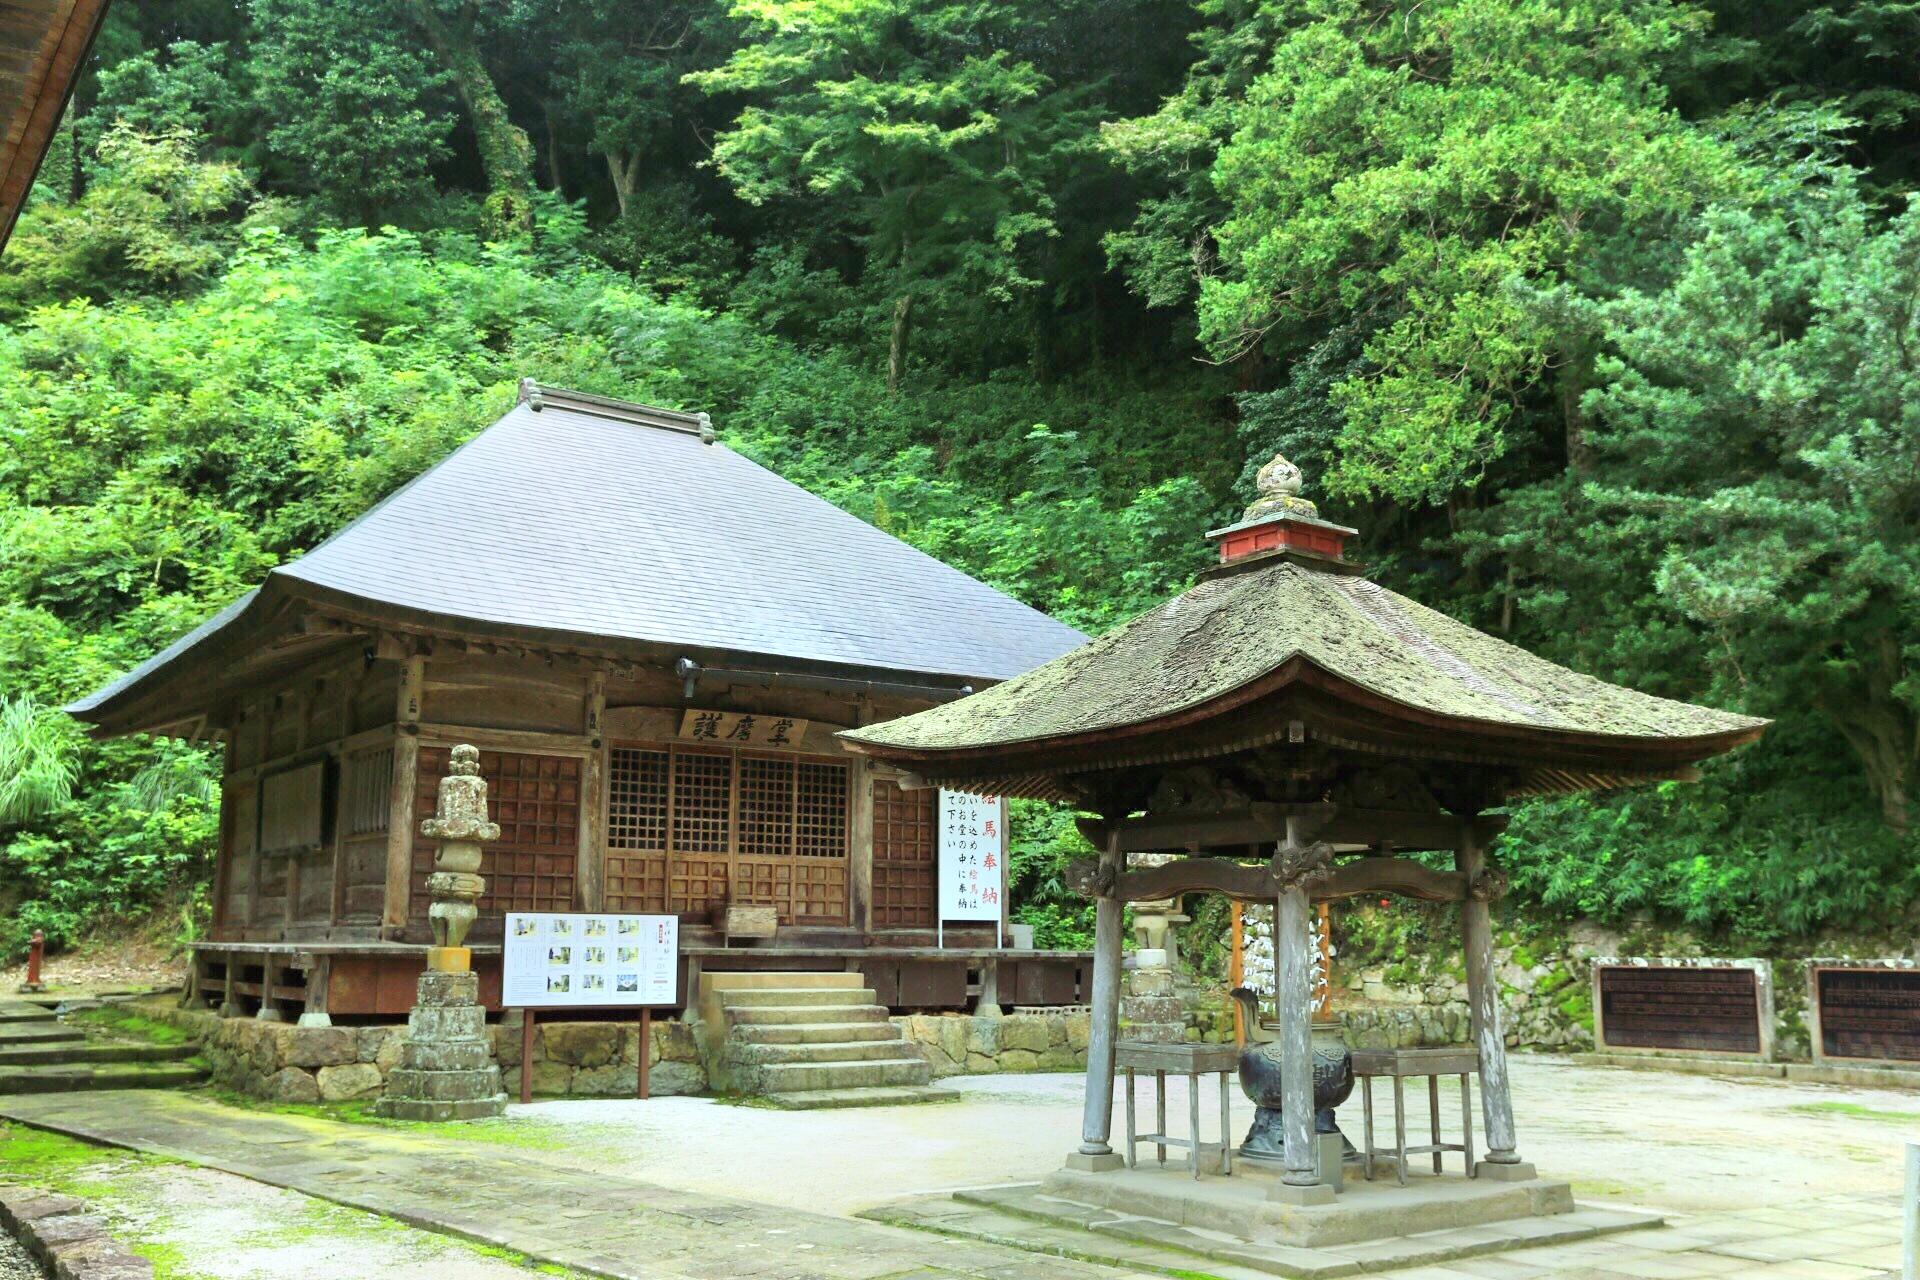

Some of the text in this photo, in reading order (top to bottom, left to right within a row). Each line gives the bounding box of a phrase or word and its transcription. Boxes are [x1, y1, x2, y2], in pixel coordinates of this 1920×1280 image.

[693, 712, 794, 747] 護摩堂
[947, 796, 956, 848] て下さい
